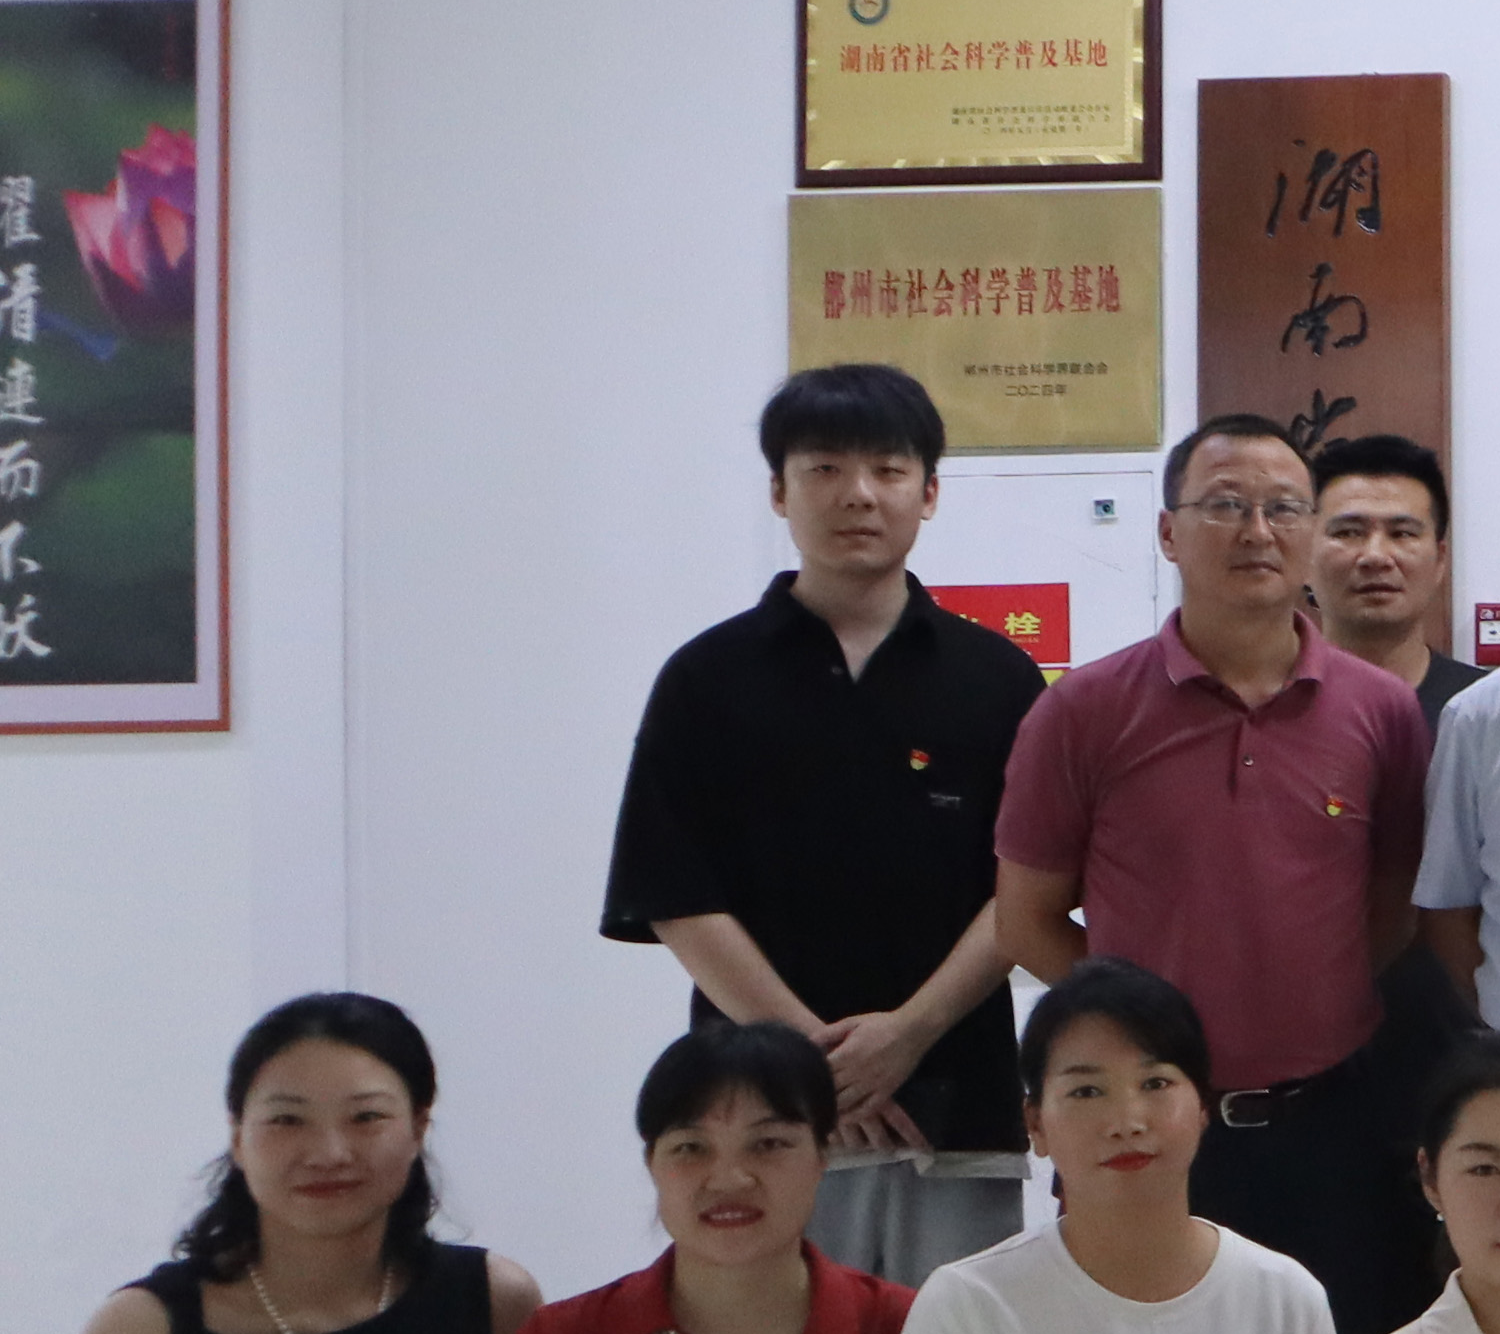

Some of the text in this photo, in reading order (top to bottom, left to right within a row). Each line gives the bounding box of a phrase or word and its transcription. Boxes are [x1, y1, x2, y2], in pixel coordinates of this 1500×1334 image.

[839, 38, 1109, 75] 湖南省社会科学普及基地
[822, 265, 1121, 320] 郴州市社会科学普及基地
